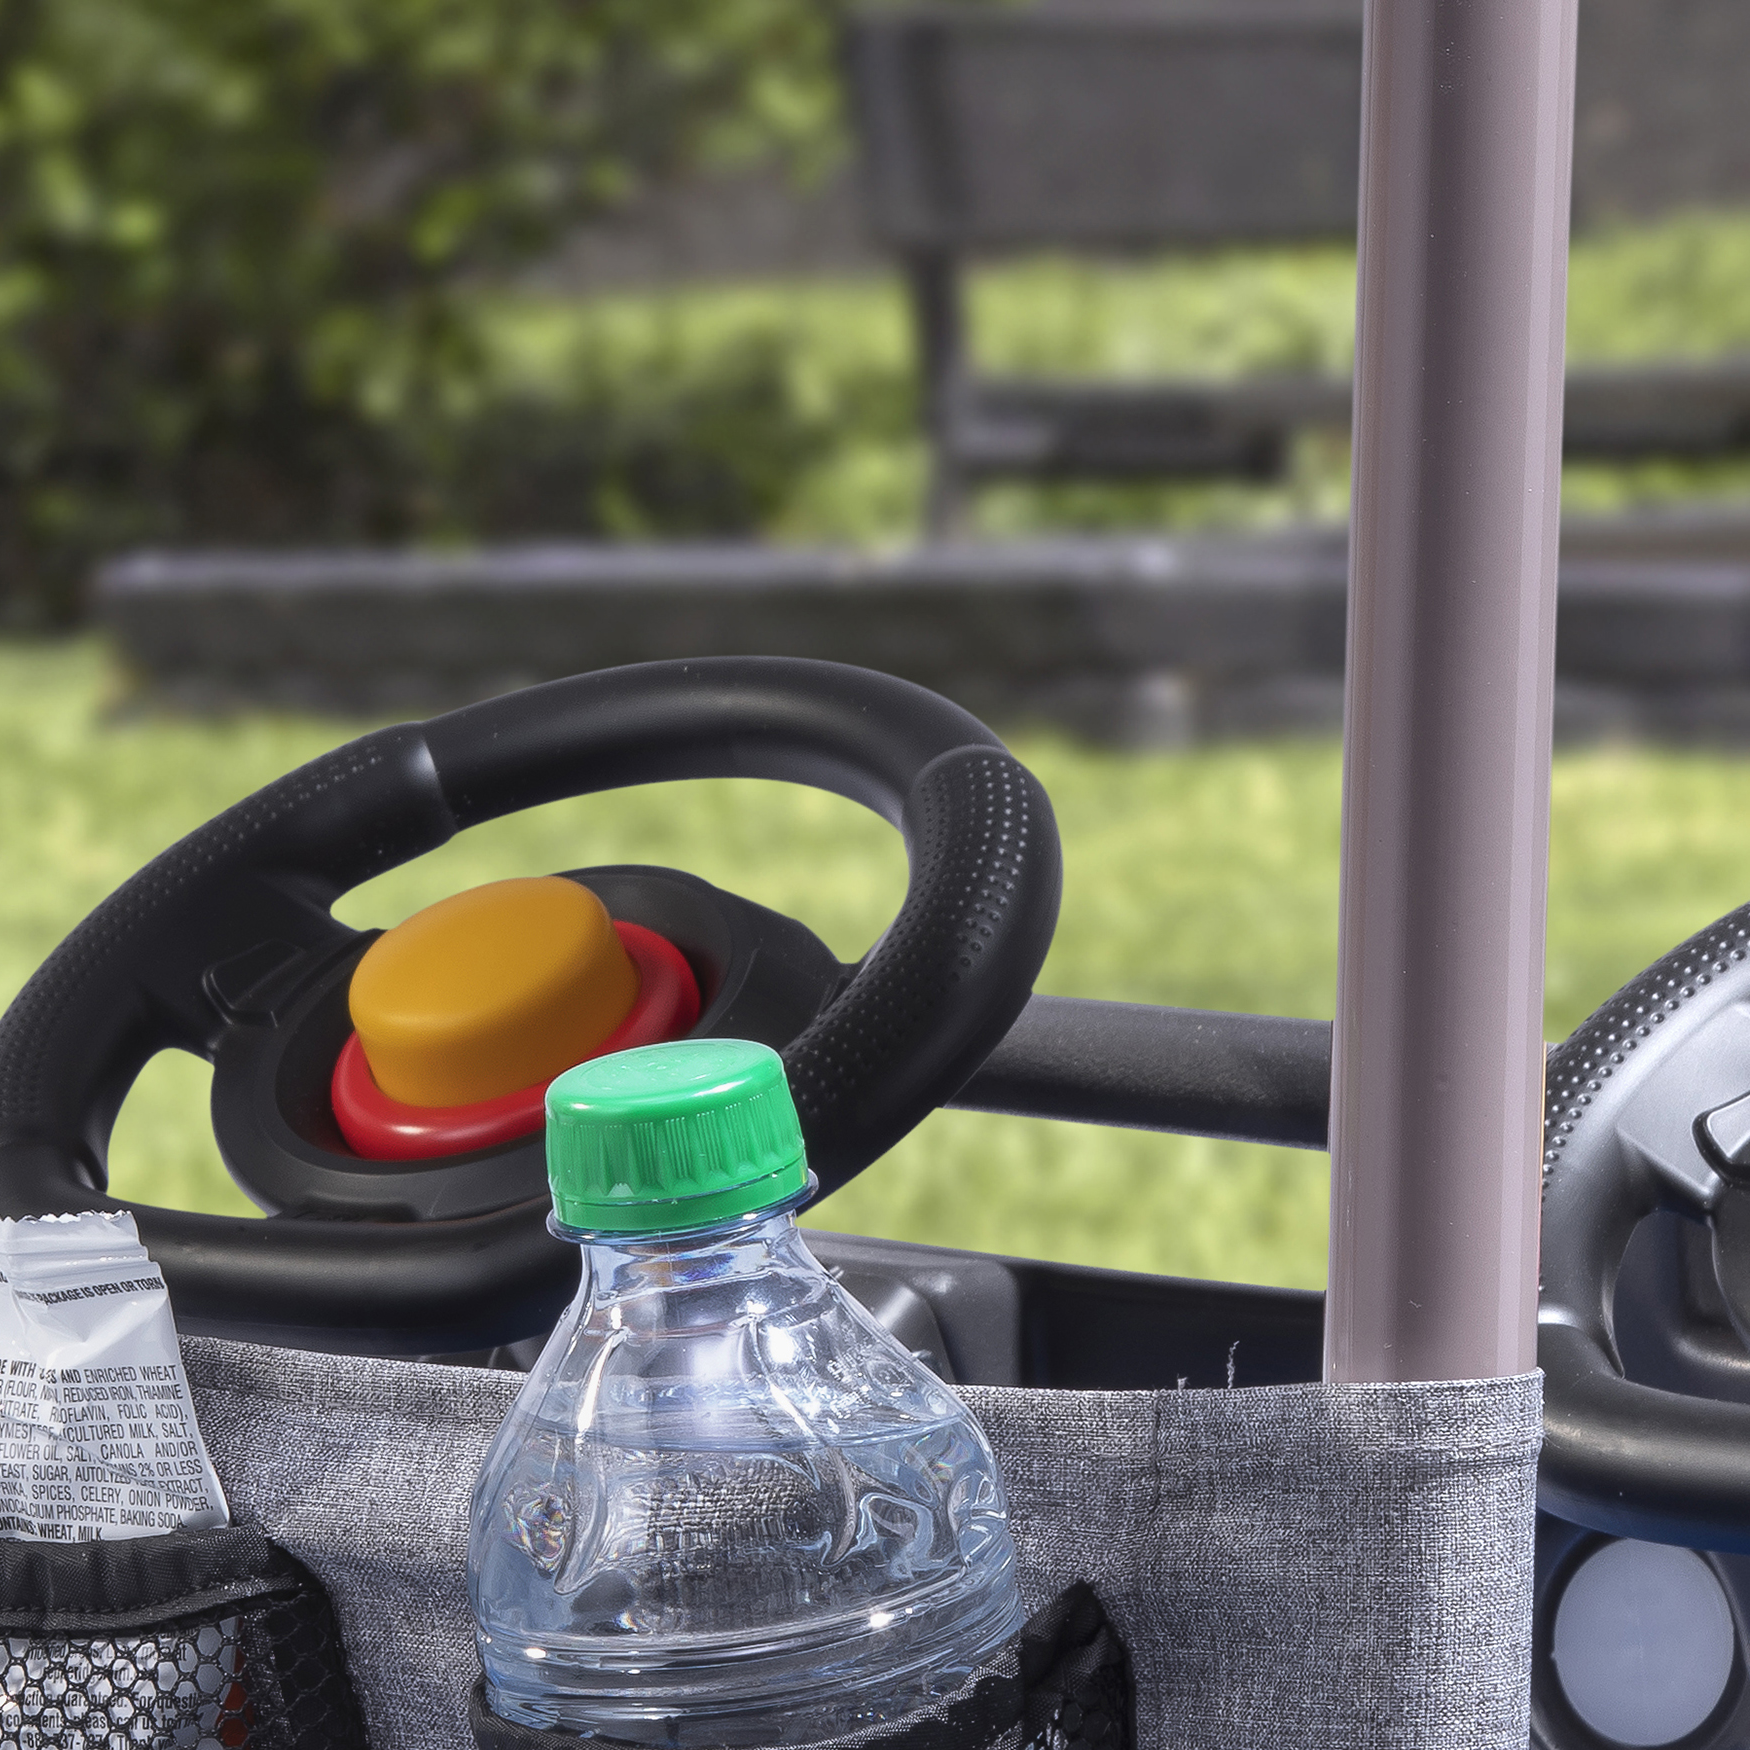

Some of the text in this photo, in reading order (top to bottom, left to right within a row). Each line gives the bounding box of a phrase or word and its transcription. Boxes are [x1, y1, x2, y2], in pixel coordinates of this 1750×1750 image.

[36, 1286, 82, 1306] PACKAGE
[81, 1285, 95, 1299] IS
[93, 1281, 123, 1297] OPEN
[121, 1279, 137, 1293] OR
[136, 1276, 165, 1291] TORN
[10, 1359, 37, 1378] WITH
[61, 1368, 81, 1384] AND
[84, 1366, 137, 1384] ENRICHED
[139, 1365, 177, 1382] WHEAT
[4, 1379, 38, 1401] (FLOUR,
[63, 1386, 109, 1403] REDUCED
[110, 1385, 137, 1402] IRON,
[136, 1384, 183, 1401] THIAMINE
[117, 1404, 147, 1419] FOLIC
[155, 1404, 188, 1422] ACID),
[128, 1422, 158, 1440] MILK,
[161, 1422, 193, 1439] SALT,
[43, 1444, 63, 1463] OIL,
[138, 1462, 155, 1478] 2%
[156, 1461, 174, 1477] OR
[175, 1459, 203, 1476] LESS
[100, 1442, 145, 1460] CANOLA
[155, 1440, 198, 1459] AND/OR
[32, 1464, 72, 1483] SUGAR,
[31, 1485, 75, 1502] SPICES,
[81, 1486, 124, 1505] CELERY,
[129, 1489, 161, 1507] ONION
[165, 1493, 214, 1512] POWDER,
[57, 1504, 118, 1526] PHOSPHATE,
[120, 1508, 155, 1527] BAKING
[37, 1522, 76, 1542] WHEAT,
